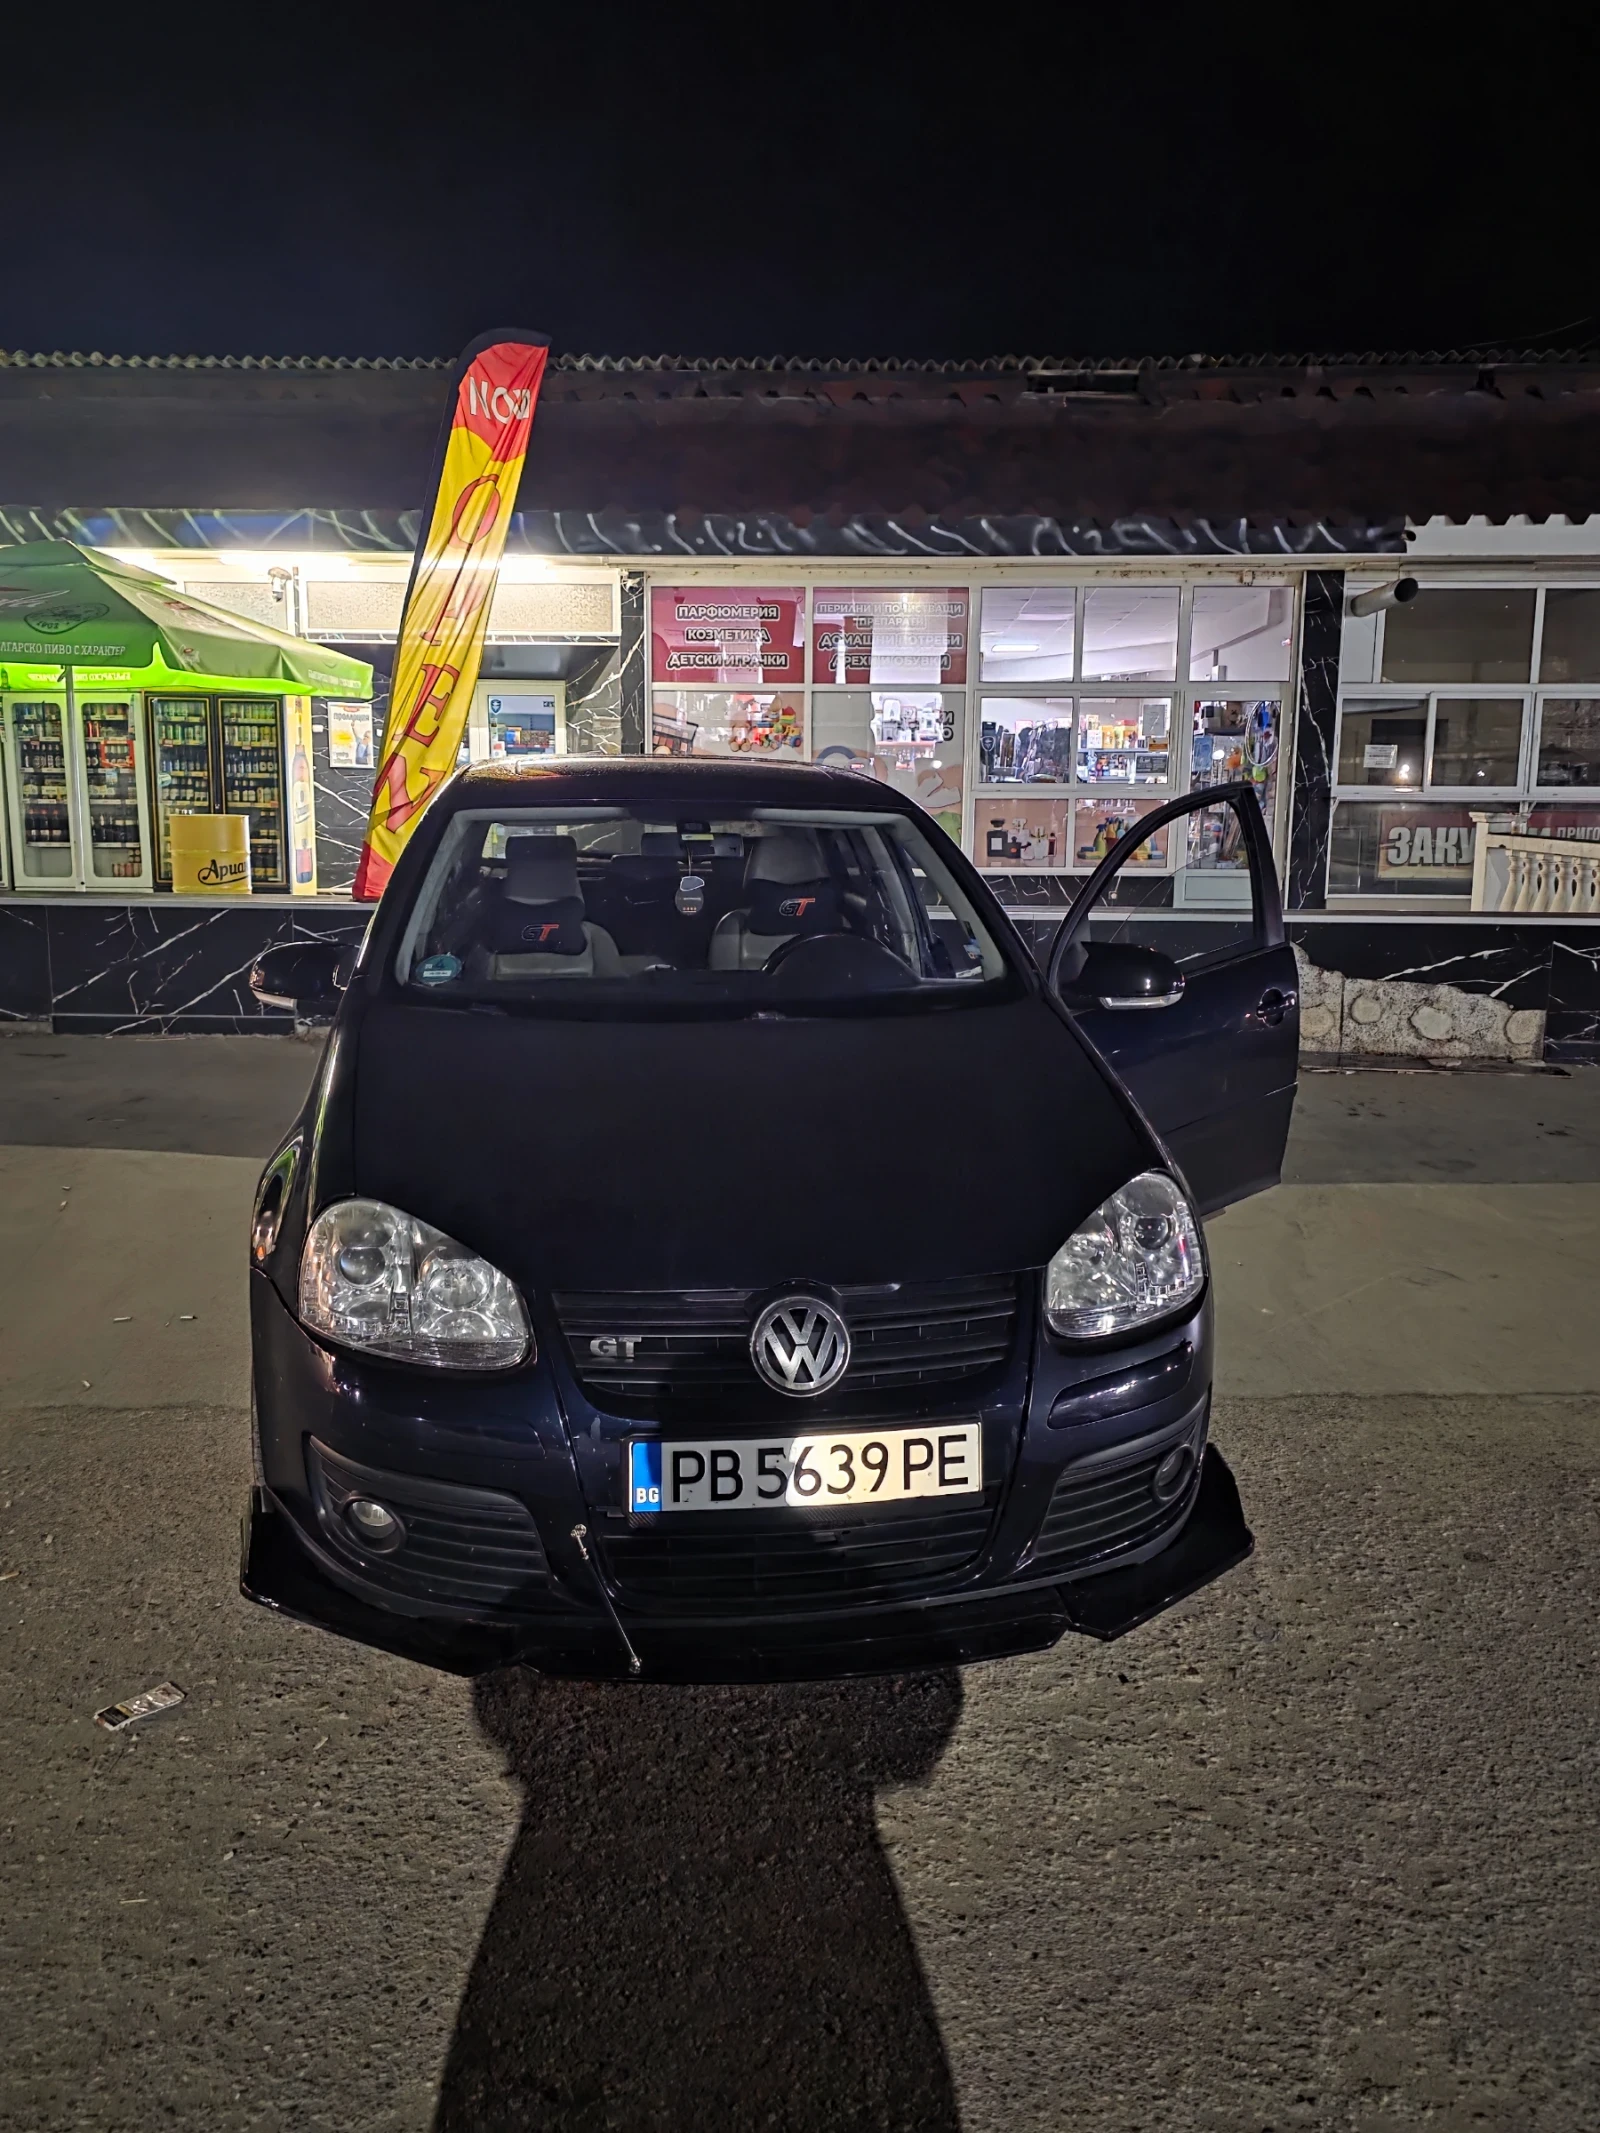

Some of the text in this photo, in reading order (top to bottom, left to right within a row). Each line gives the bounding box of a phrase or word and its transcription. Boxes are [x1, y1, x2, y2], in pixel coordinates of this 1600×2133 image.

[678, 605, 778, 618] ПАРФЮМЕРИЯ
[687, 629, 769, 641] КОЗМЕТИКА
[44, 643, 72, 655] ПИВО
[74, 645, 80, 655] С
[81, 645, 126, 656] ХАРАКТЕР
[669, 653, 786, 667] ДЕТСКИ ИГРАЧКИ
[1387, 826, 1484, 866] ЗАКУ
[198, 859, 247, 885] Ариа
[779, 898, 816, 916] GT
[521, 924, 559, 942] GT
[590, 1336, 642, 1359] GT
[760, 1304, 842, 1391] VW
[636, 1434, 969, 1504] BG PB 5639 PE
